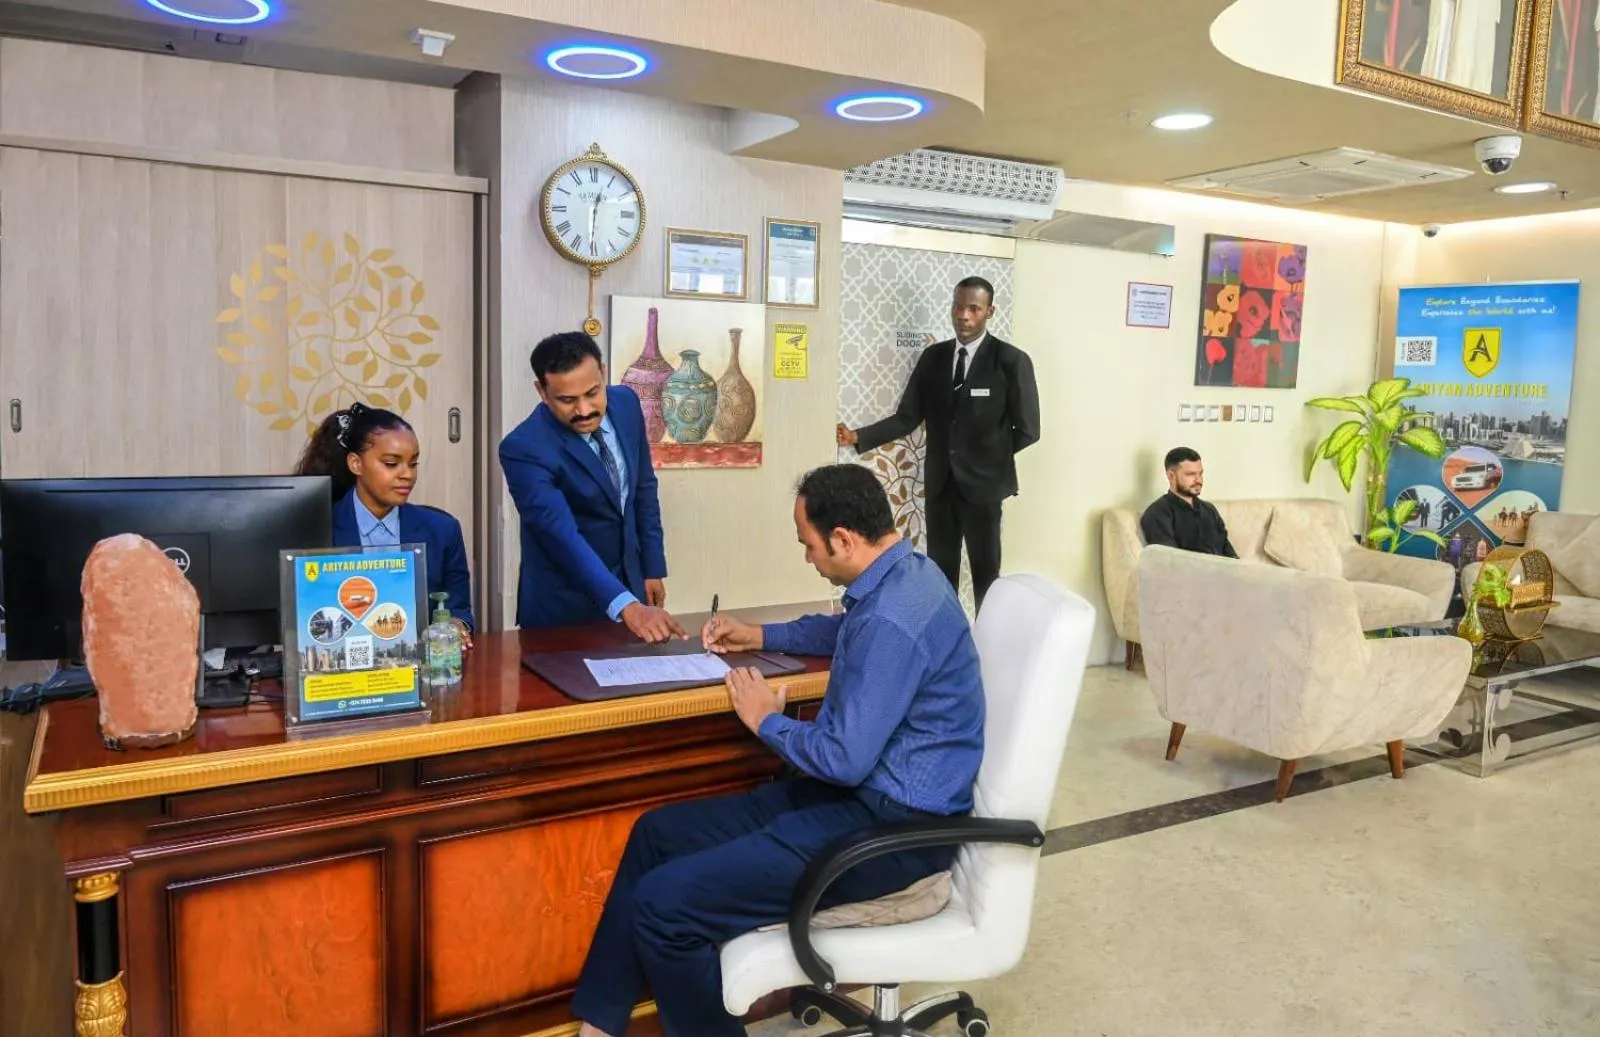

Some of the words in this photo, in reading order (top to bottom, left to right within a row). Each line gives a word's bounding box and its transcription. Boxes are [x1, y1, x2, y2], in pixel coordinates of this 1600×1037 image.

[1460, 296, 1490, 307] Beyond
[1495, 295, 1546, 304] Boundaries
[896, 331, 922, 339] SLIDING
[896, 339, 921, 348] DOOR
[1469, 333, 1492, 362] A
[1465, 383, 1548, 398] ADVENTURE
[322, 561, 355, 572] ARIYAN
[356, 558, 407, 570] ADVENTURE
